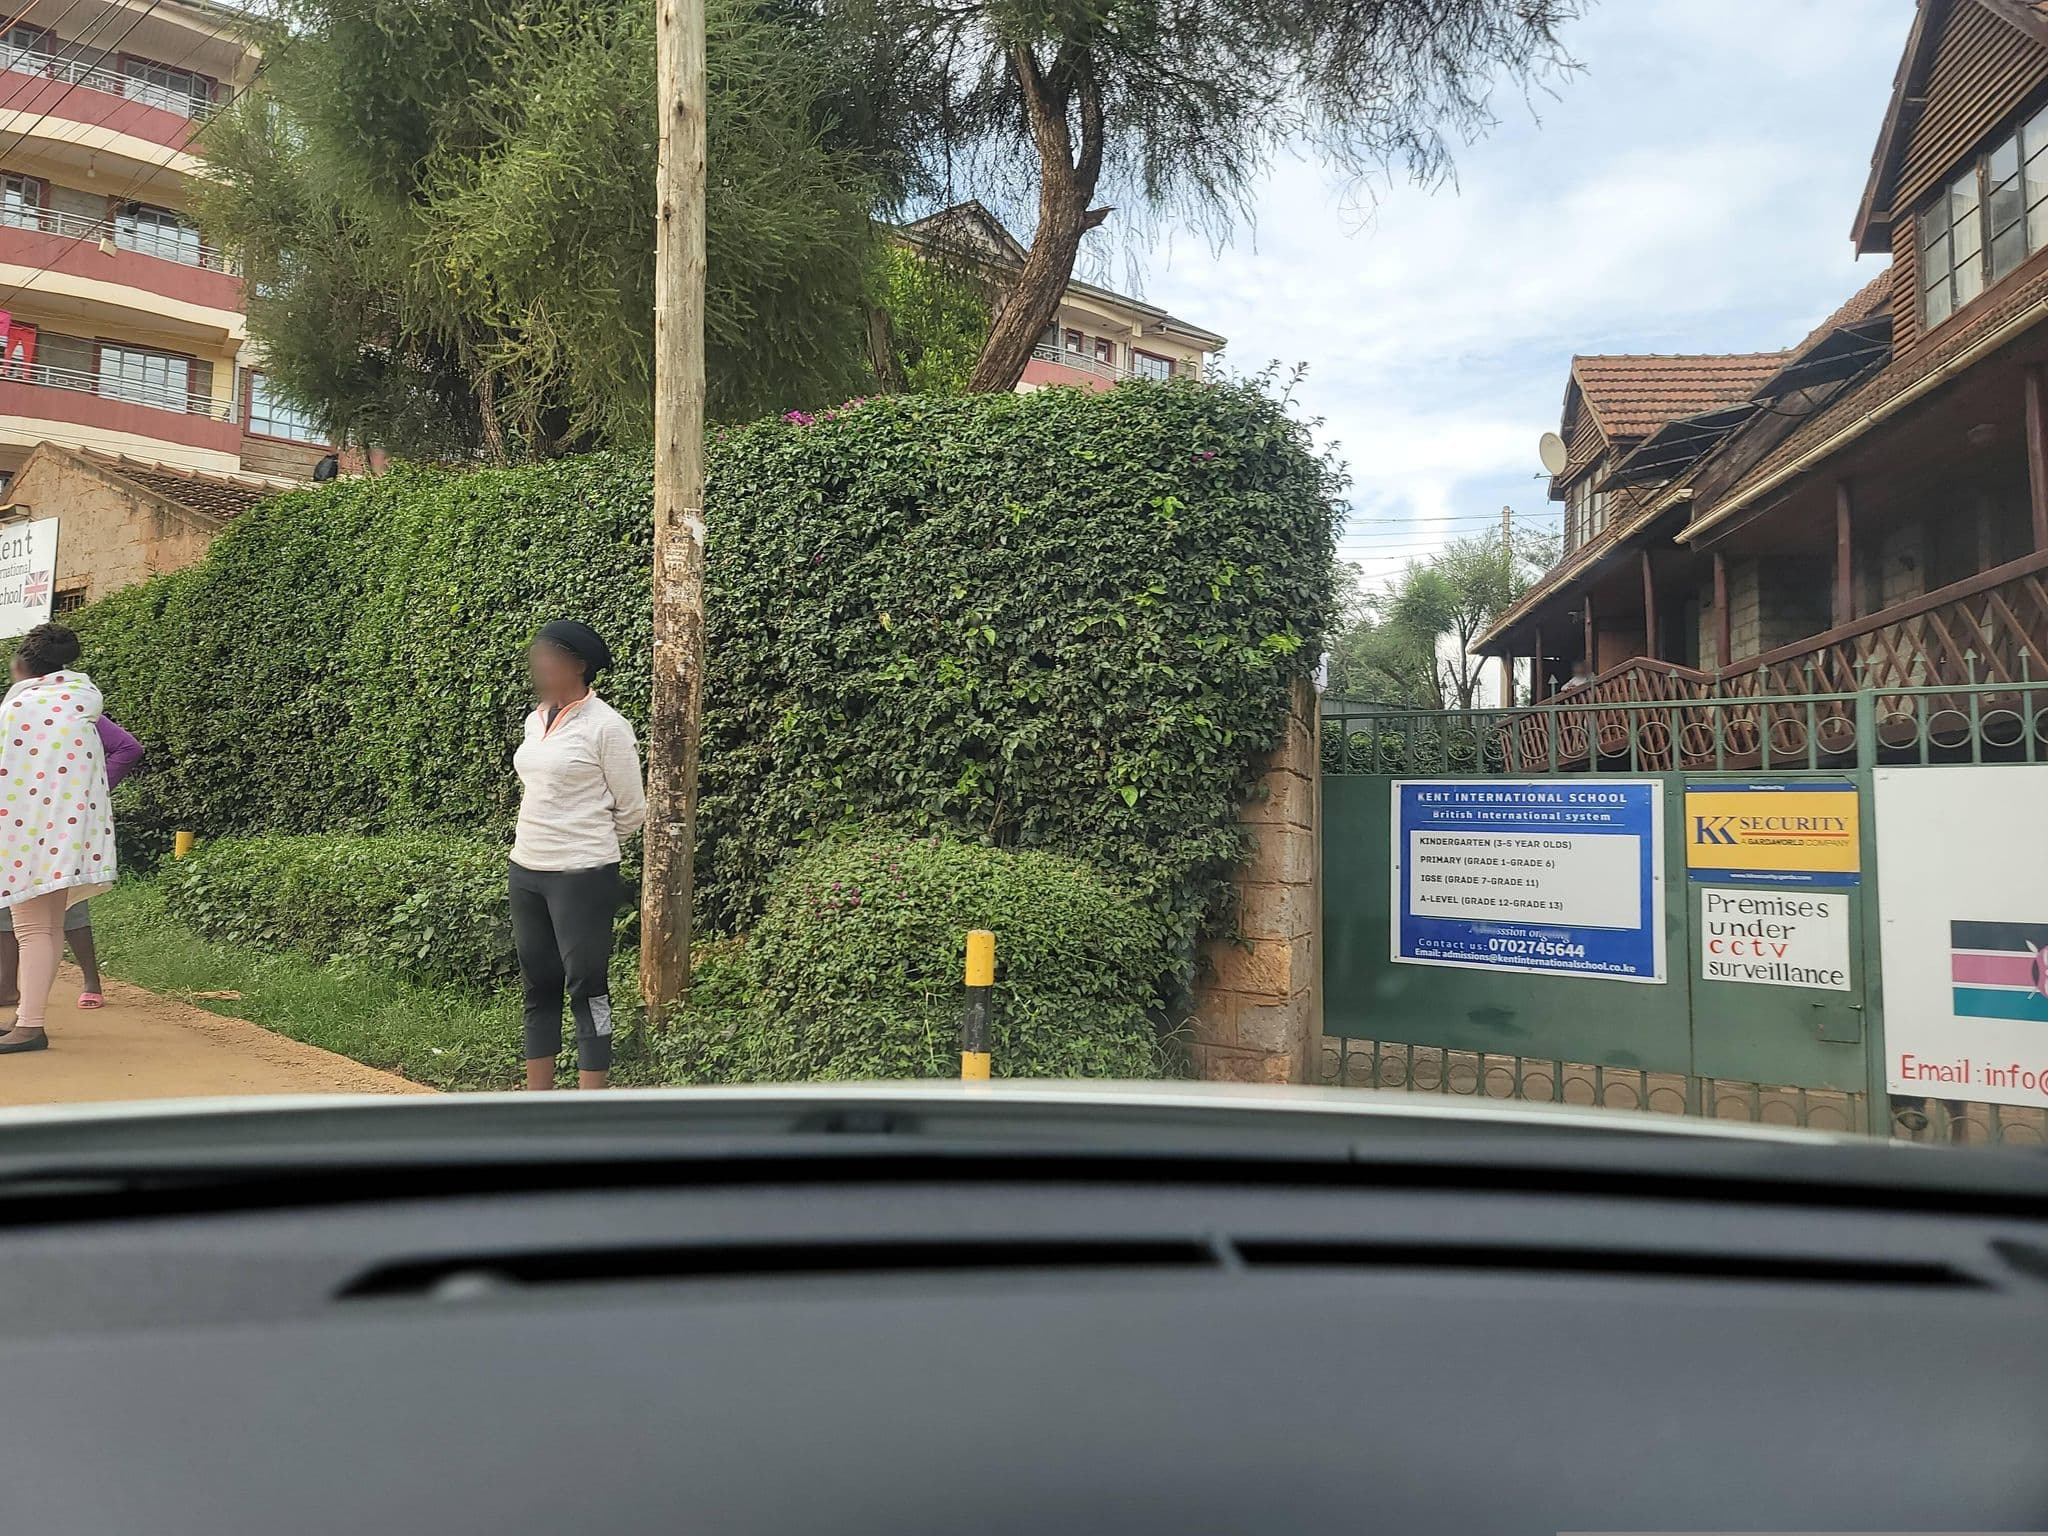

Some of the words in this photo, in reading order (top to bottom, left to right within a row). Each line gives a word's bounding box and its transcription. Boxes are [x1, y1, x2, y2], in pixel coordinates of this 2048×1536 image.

[0, 529, 32, 561] ent
[0, 584, 22, 606] chool
[1418, 792, 1450, 802] KENT
[1455, 793, 1563, 803] INTERNATIONAL
[1569, 793, 1628, 804] SCHOOL
[1432, 810, 1473, 820] British
[1477, 811, 1561, 821] International
[1565, 812, 1611, 822] system
[1693, 815, 1738, 845] KK
[1739, 816, 1848, 831] SECURITY
[1419, 837, 1491, 847] KINDERGARTEN
[1493, 839, 1513, 848] (3-5
[1515, 840, 1540, 848] YEAR
[1543, 840, 1572, 850] OLDS)
[1420, 855, 1462, 864] PRIMARY
[1464, 857, 1498, 866] (GRADE
[1501, 858, 1543, 867] 1-GRADE
[1545, 860, 1555, 869] 6)
[1420, 874, 1443, 883] IGSE
[1444, 875, 1479, 885] (GRADE
[1481, 877, 1523, 886] 7-GRADE
[1525, 878, 1539, 888] 11)
[1420, 894, 1459, 904] A-LEVEL
[1461, 896, 1496, 906] (GRADE
[1499, 899, 1546, 908] 12-GRADE
[1548, 901, 1563, 911] 13)
[1707, 893, 1829, 918] Premises
[1709, 919, 1796, 940] under
[1418, 938, 1465, 949] Contact
[1709, 938, 1789, 958] cctv
[1414, 948, 1441, 957] Email:
[1709, 961, 1845, 986] surveillance
